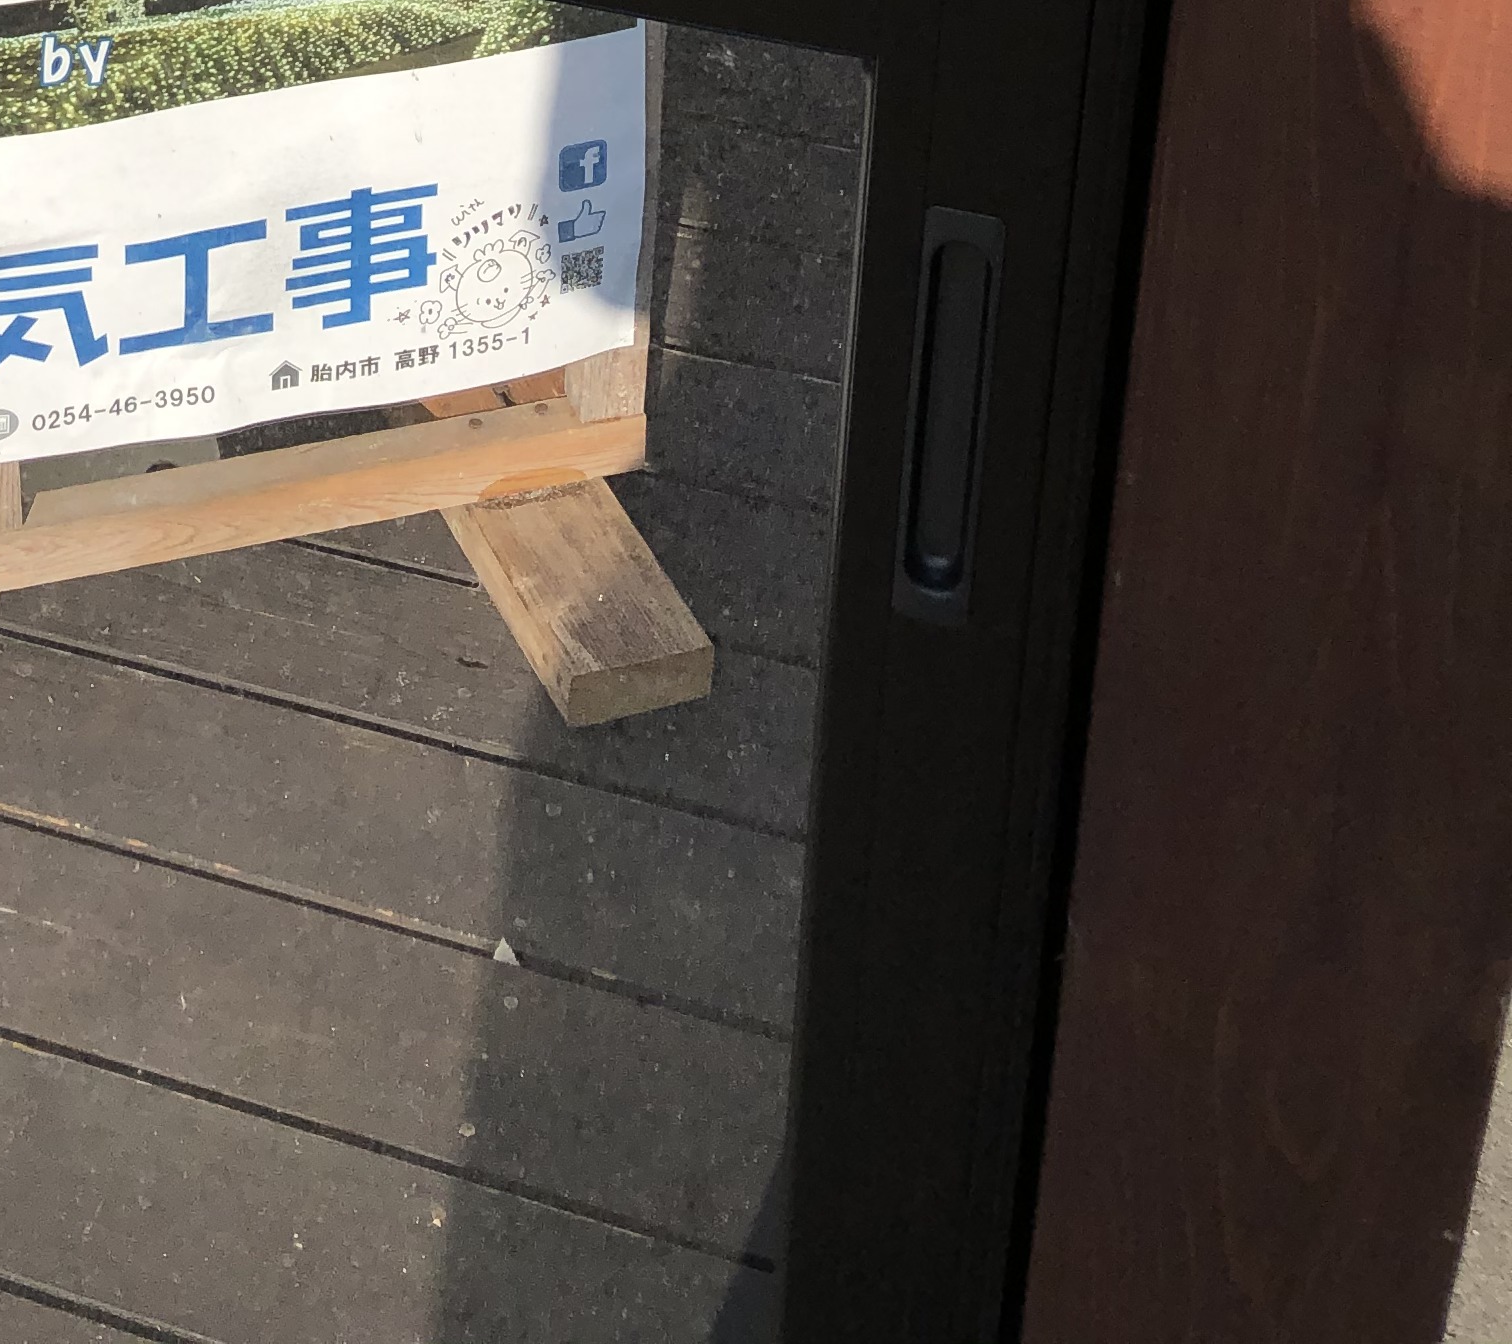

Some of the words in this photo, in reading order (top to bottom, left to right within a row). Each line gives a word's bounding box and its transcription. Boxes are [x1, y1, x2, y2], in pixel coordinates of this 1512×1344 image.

[39, 32, 114, 91] by
[309, 355, 381, 384] 胎内市
[393, 342, 440, 372] 高野
[448, 326, 531, 360] 1355-1
[31, 384, 216, 432] 0254-46-3950
